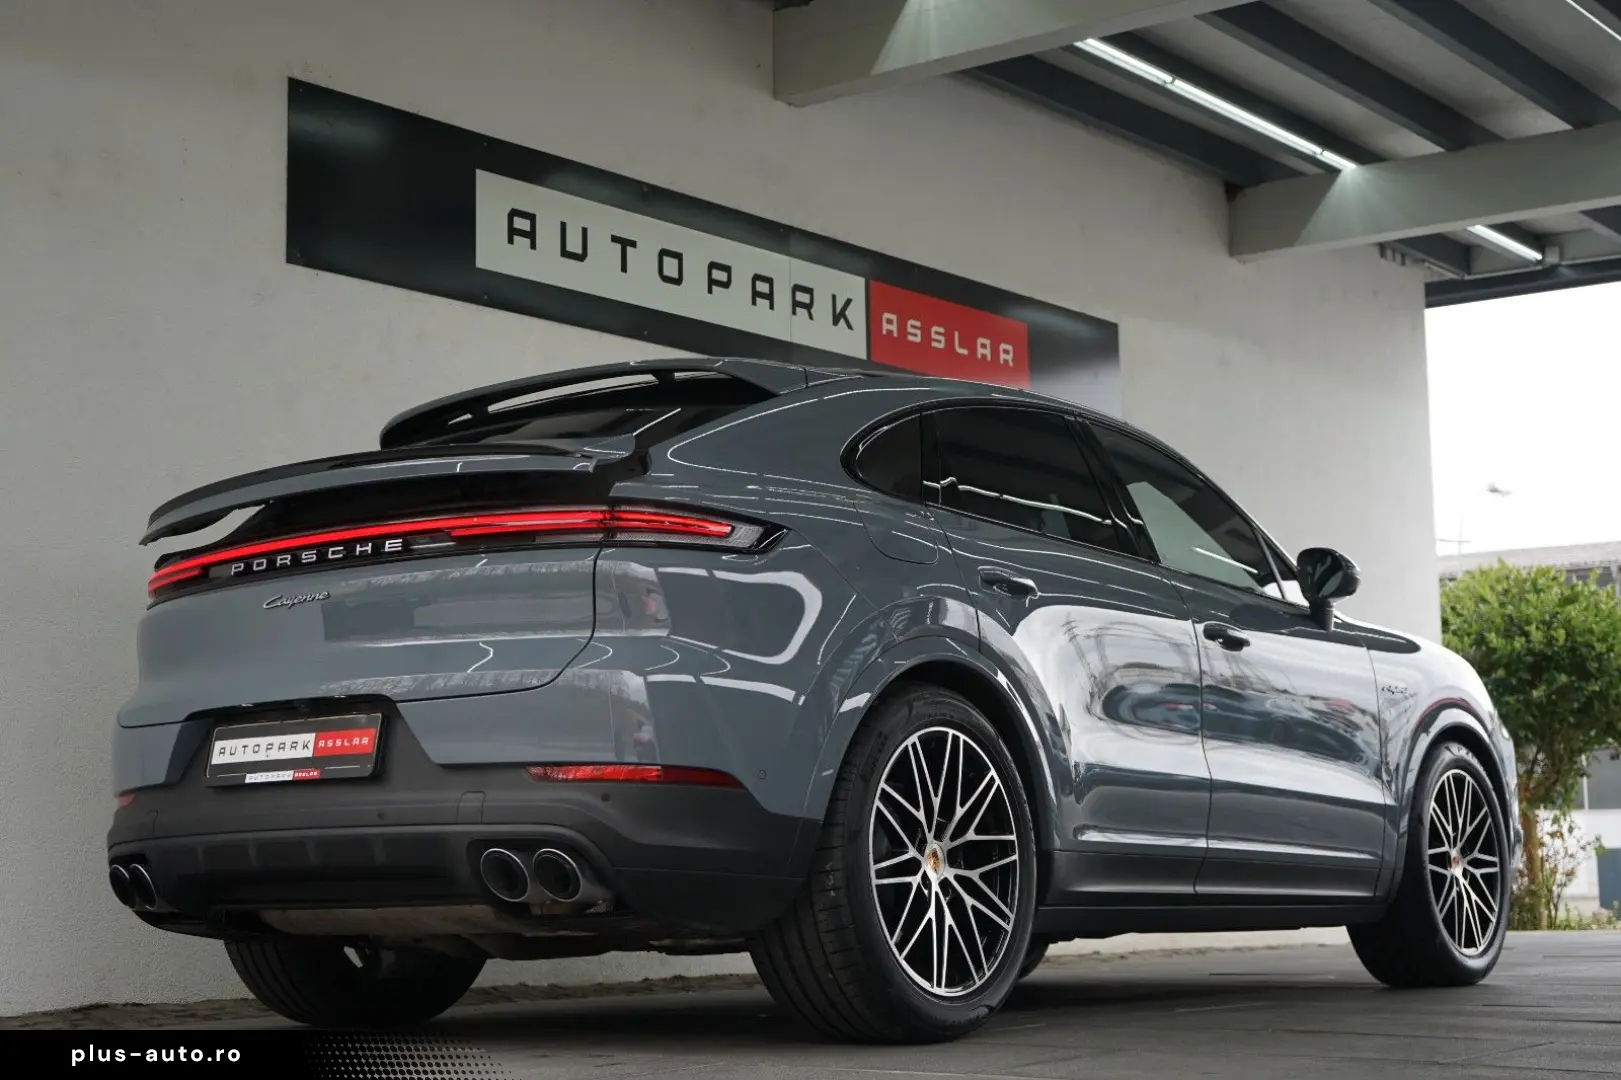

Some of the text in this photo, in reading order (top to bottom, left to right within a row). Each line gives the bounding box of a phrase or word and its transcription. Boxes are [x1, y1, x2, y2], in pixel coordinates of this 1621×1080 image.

[507, 207, 1014, 366] AUTOPARK ASSLAR
[231, 539, 403, 576] PORSCHE
[263, 590, 331, 609] Cayenne
[218, 736, 369, 757] AUTOPARK ASSLAR
